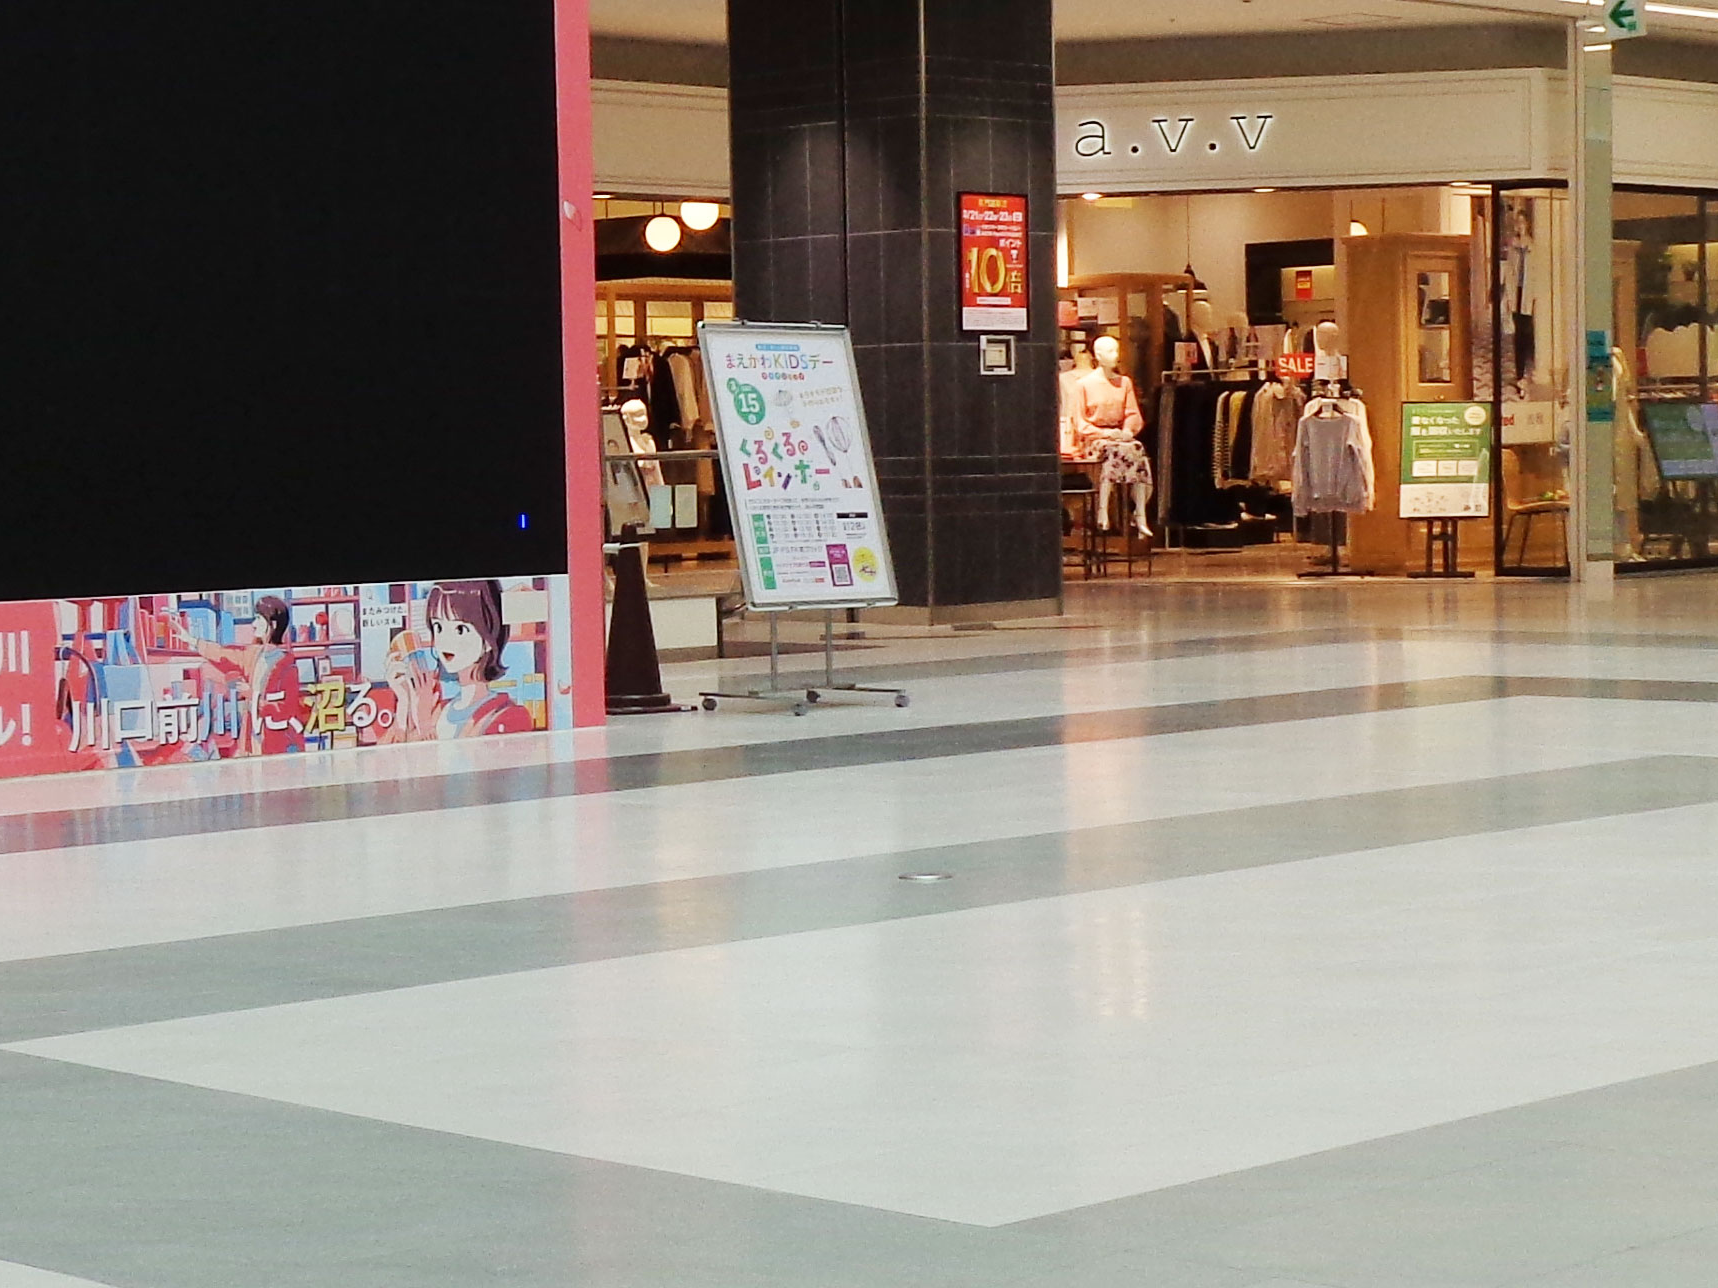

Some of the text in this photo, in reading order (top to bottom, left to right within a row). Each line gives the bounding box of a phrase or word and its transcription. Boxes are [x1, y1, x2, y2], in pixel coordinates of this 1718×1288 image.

[1074, 114, 1274, 158] a.v.v
[1278, 356, 1314, 374] SALE
[738, 393, 760, 413] 15
